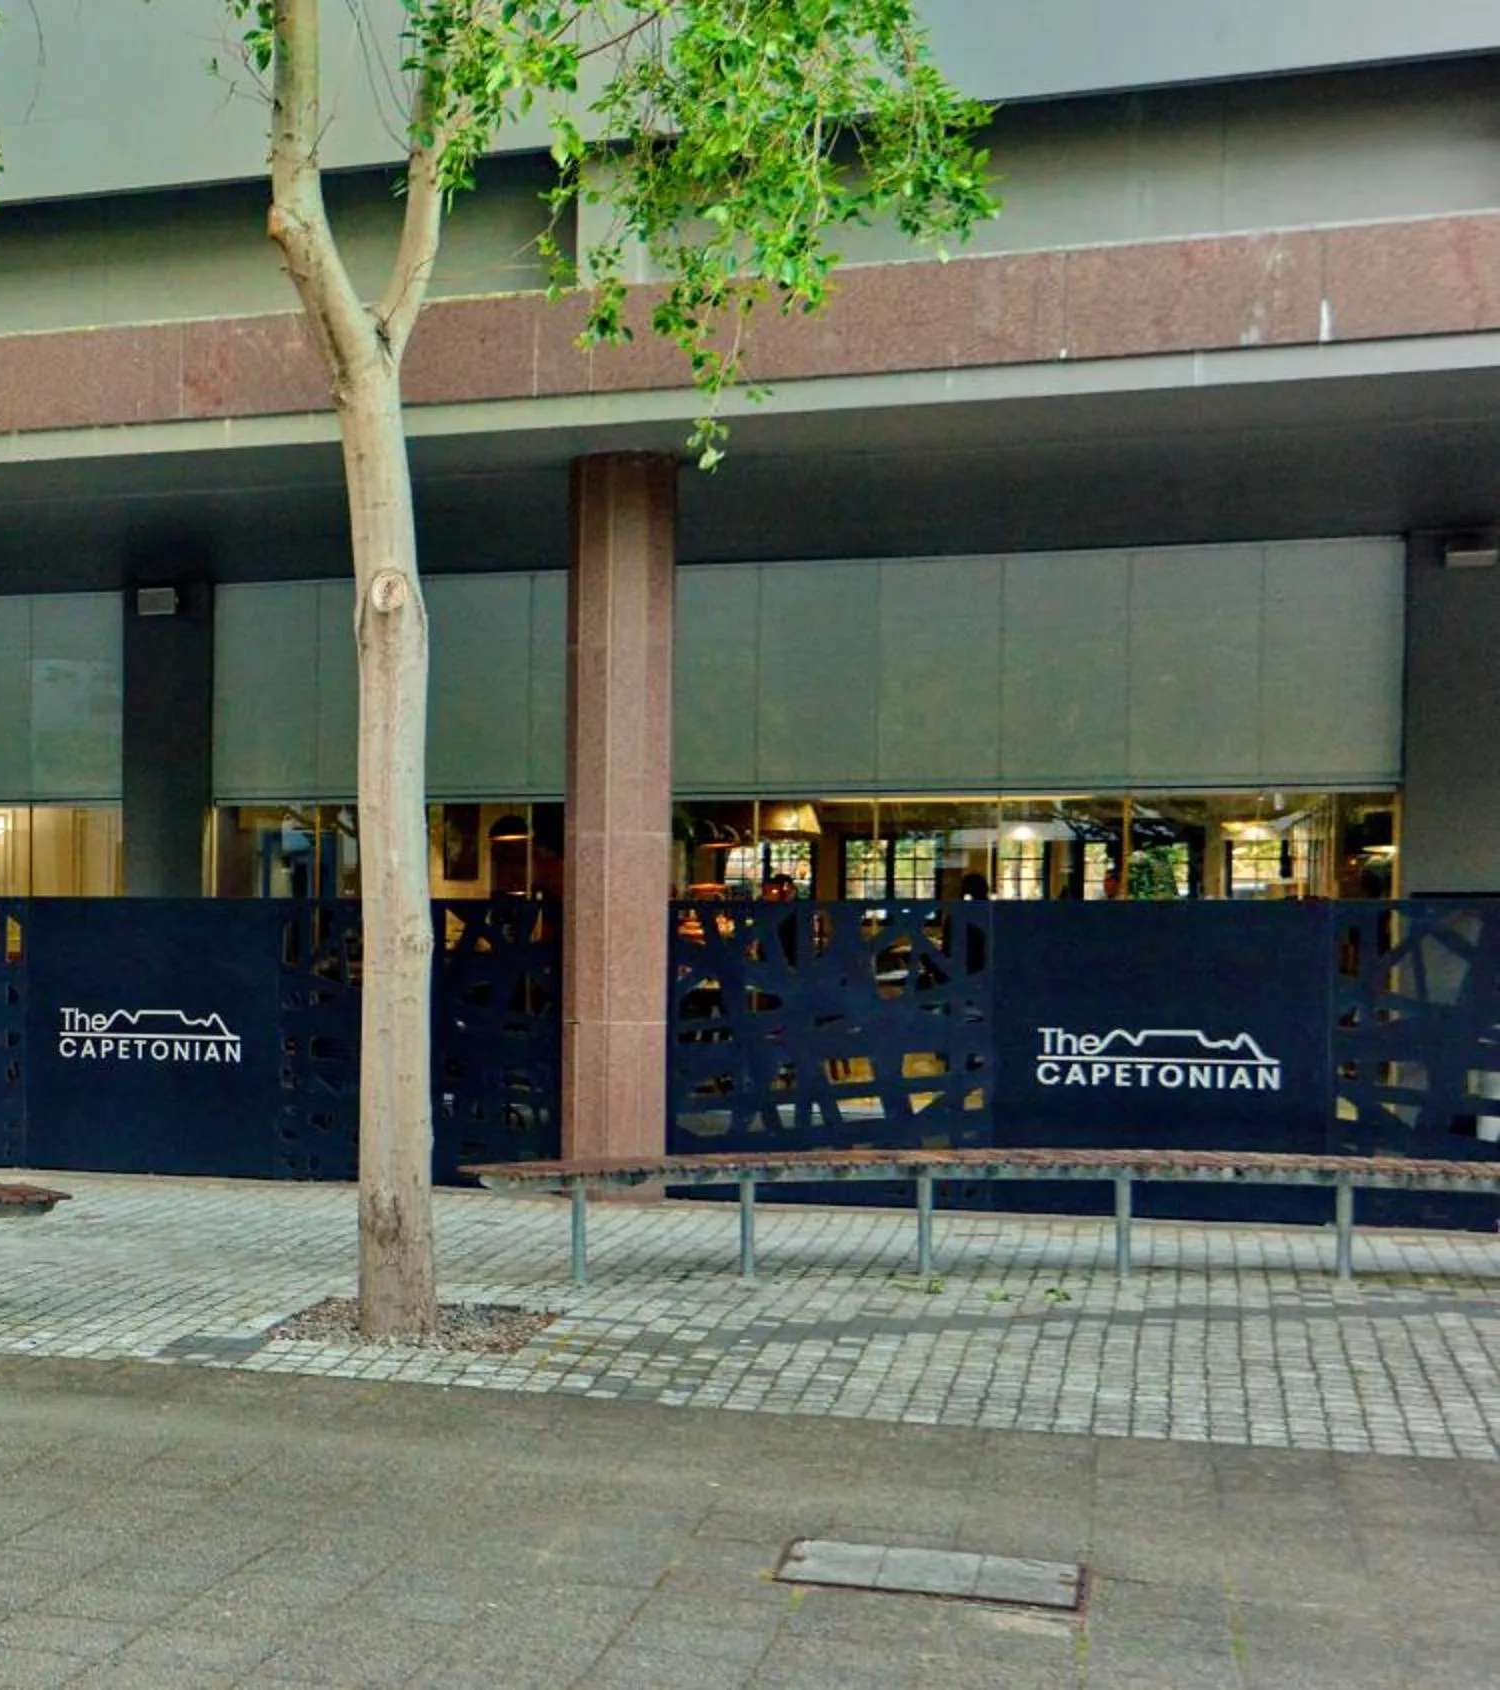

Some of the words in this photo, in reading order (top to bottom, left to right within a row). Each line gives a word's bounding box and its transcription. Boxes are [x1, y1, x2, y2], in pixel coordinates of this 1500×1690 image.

[60, 1007, 107, 1032] The
[59, 1038, 241, 1063] CAPETONIAN
[1037, 1026, 1099, 1055] The
[1036, 1062, 1281, 1090] CAPETONIAN
